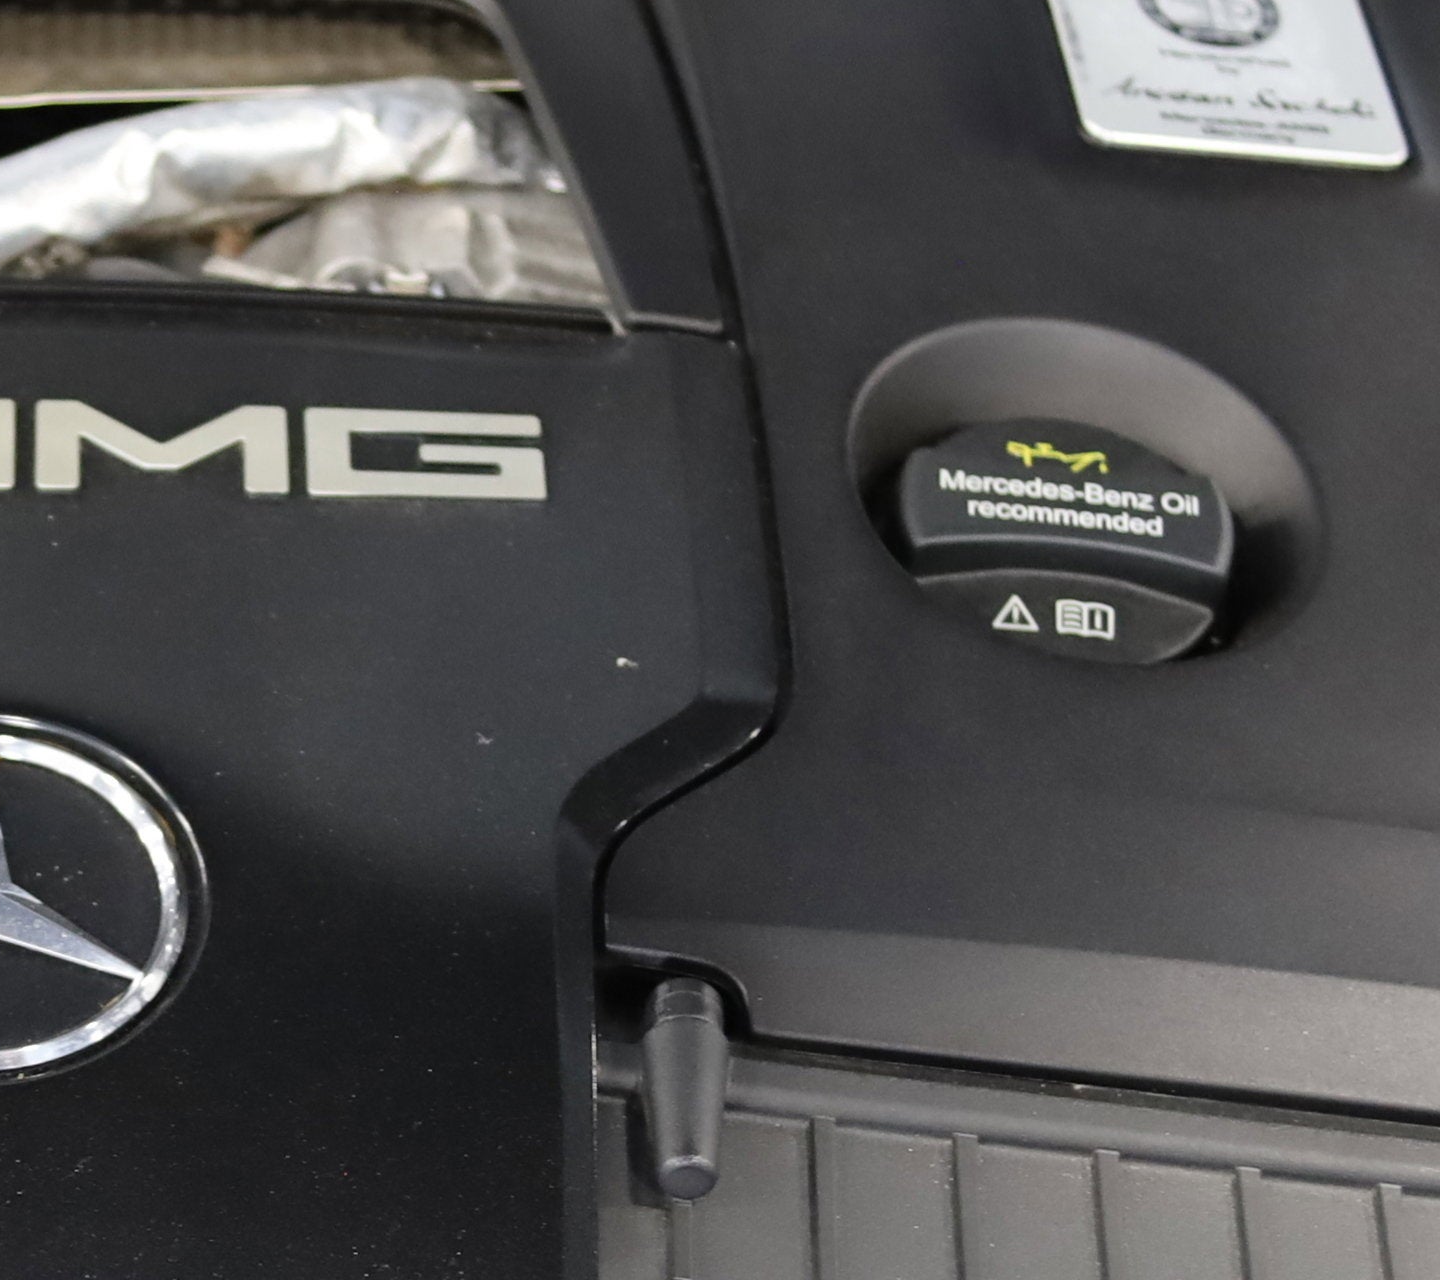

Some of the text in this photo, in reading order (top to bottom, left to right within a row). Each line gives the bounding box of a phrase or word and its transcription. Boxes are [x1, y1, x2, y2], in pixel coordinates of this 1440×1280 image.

[938, 467, 1200, 517] Mercedes-Benz Oil
[966, 497, 1165, 538] recommended
